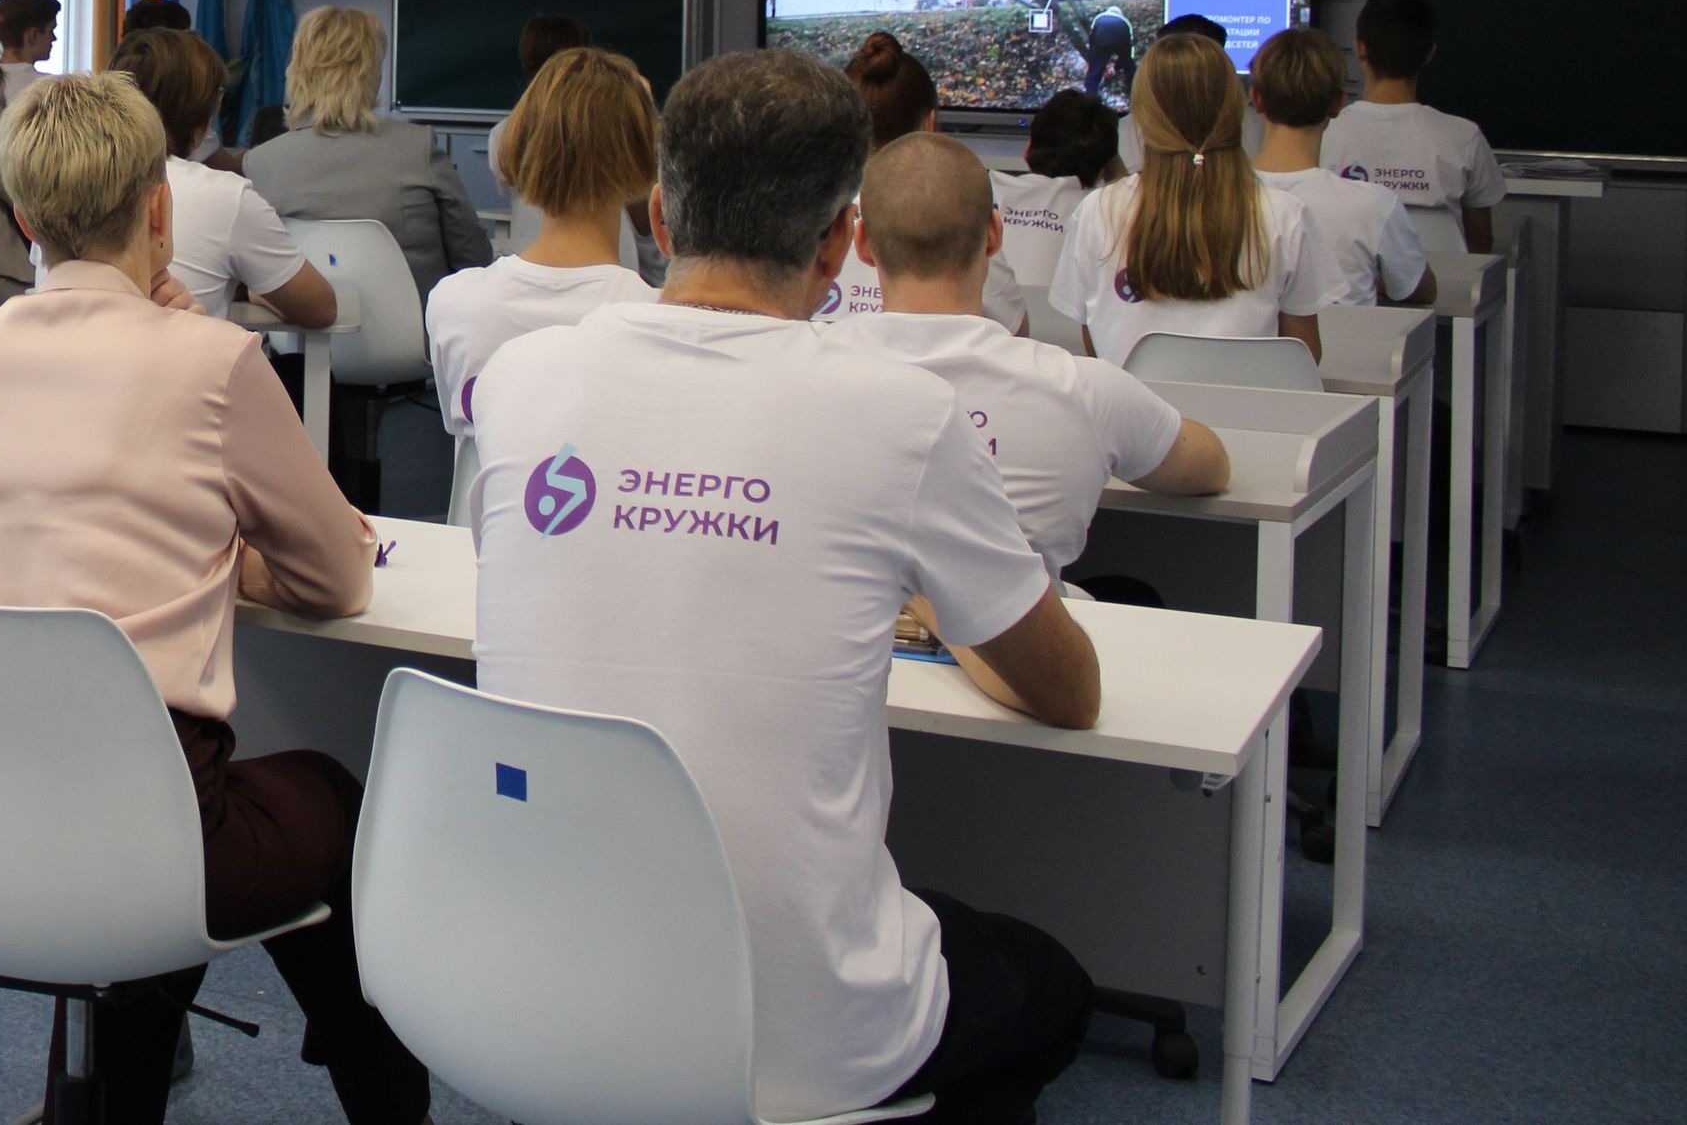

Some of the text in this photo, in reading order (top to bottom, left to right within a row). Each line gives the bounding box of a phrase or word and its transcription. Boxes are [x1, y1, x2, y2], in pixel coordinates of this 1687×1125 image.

[1257, 16, 1271, 24] ПО
[1374, 168, 1426, 179] ЭНЕРГО
[1005, 206, 1059, 220] ЭНЕРГО
[1004, 216, 1064, 233] КРУЖКИ
[616, 469, 772, 504] ЭНЕРГО
[612, 505, 780, 546] КРУЖКИ
